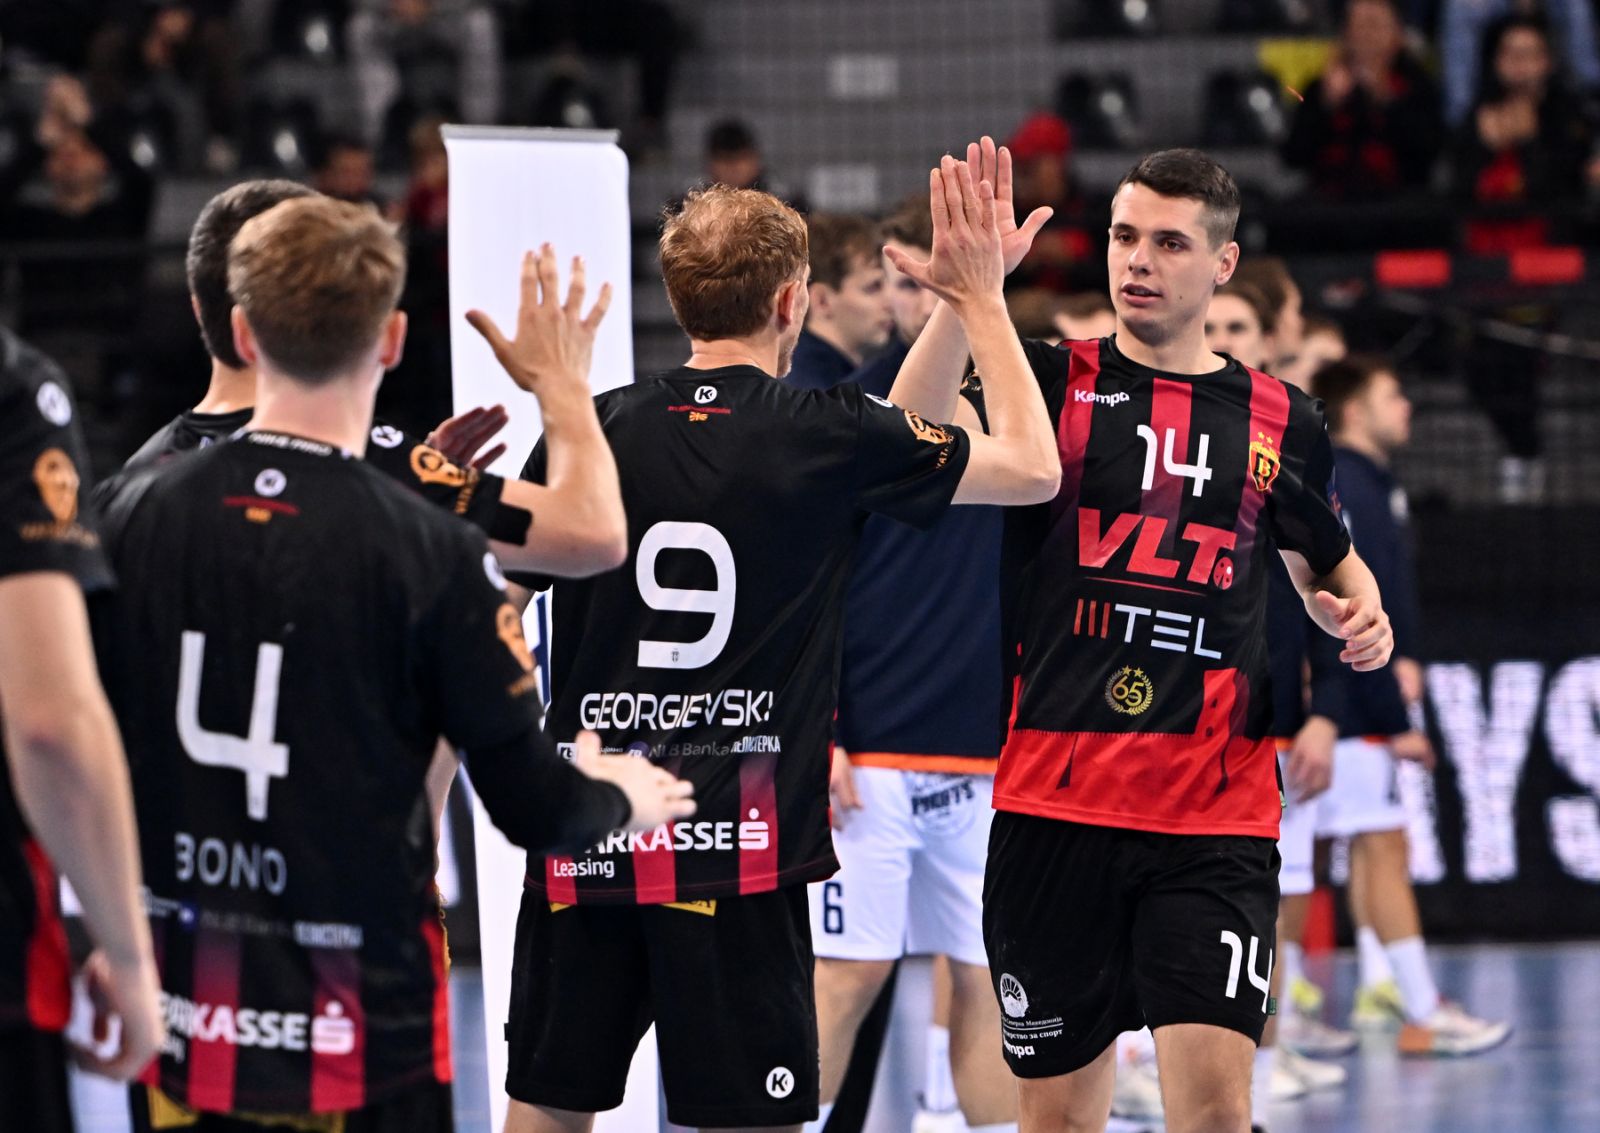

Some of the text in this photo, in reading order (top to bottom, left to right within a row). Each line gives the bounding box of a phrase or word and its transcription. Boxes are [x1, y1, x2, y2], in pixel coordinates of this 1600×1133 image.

[1074, 389, 1130, 406] Kempa
[1137, 424, 1212, 497] 14
[1077, 507, 1237, 584] VLT
[636, 521, 736, 669] 9
[1112, 675, 1144, 707] 65
[176, 630, 289, 821] 4
[682, 741, 728, 757] Banka
[174, 832, 287, 895] BONO
[553, 858, 615, 878] Leasing
[823, 882, 844, 934] 6
[1220, 930, 1273, 1014] 14
[1039, 1029, 1063, 1038] спорт
